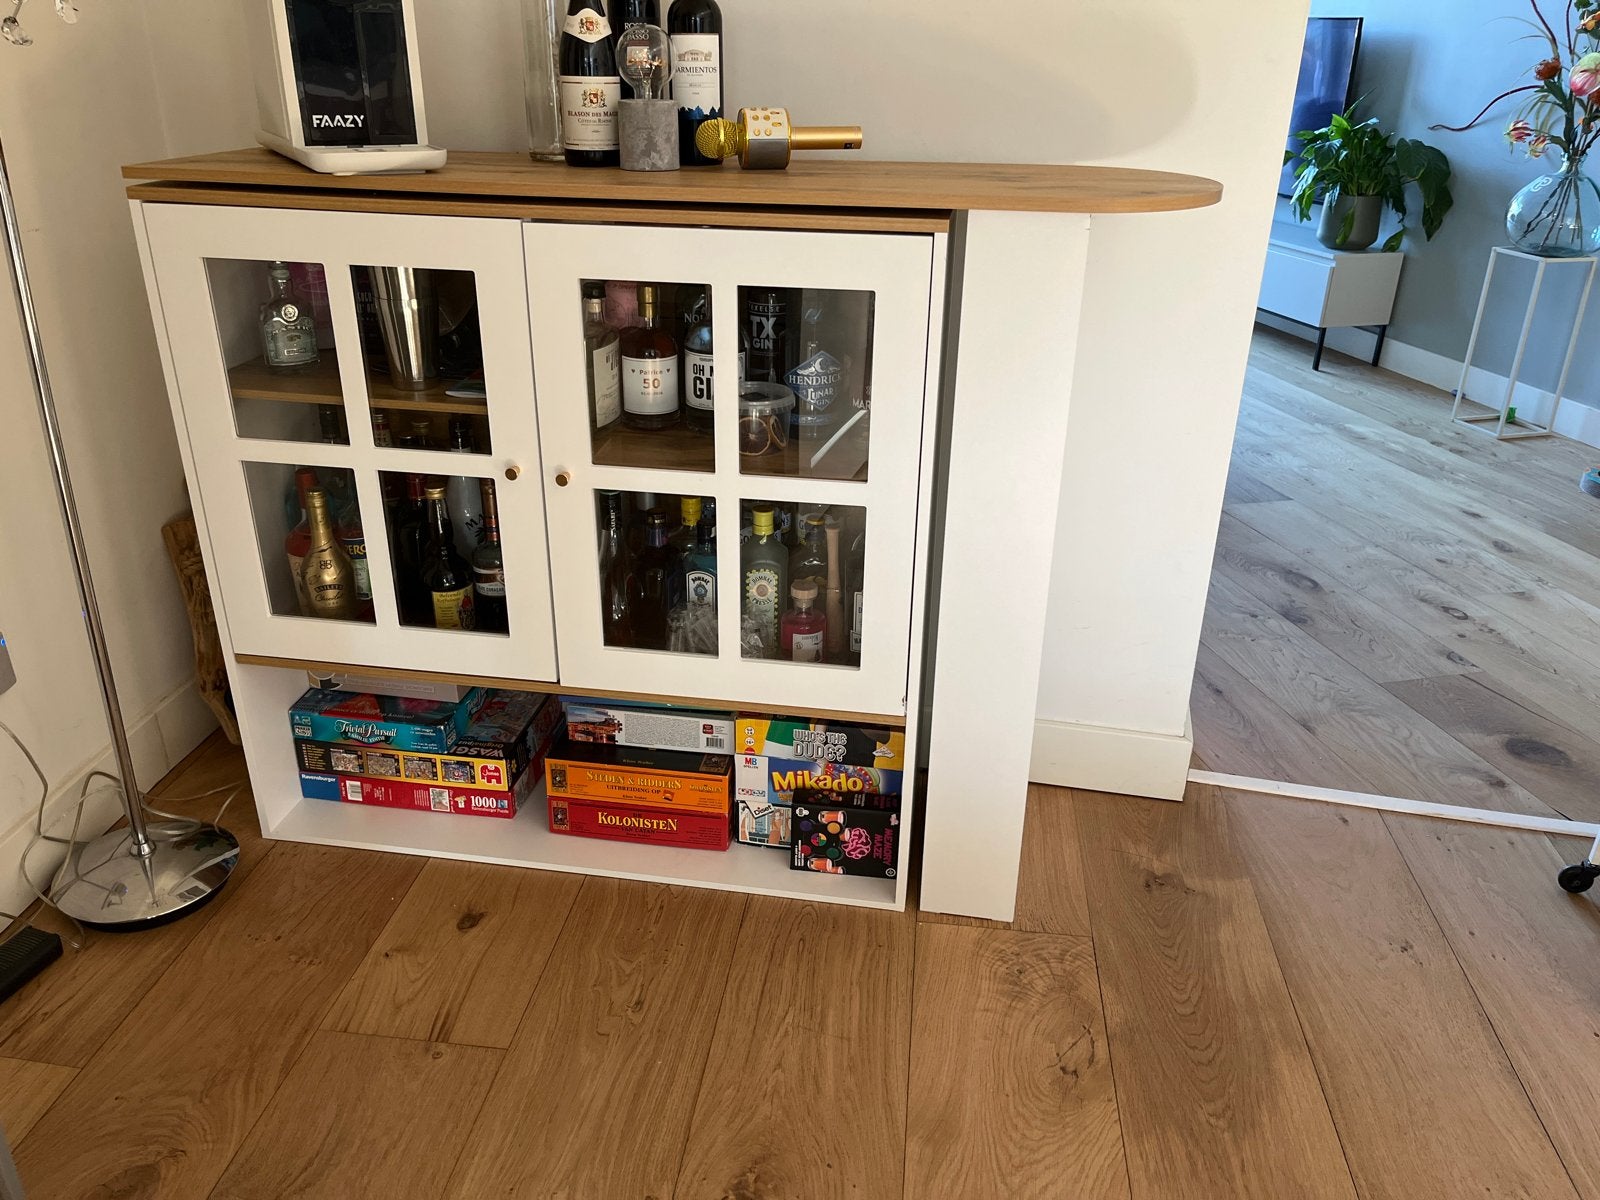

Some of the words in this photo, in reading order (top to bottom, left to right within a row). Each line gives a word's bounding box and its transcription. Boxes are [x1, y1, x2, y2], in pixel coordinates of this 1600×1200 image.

[312, 114, 365, 128] FAAZY
[750, 314, 777, 339] TX
[752, 338, 773, 350] GIN
[692, 363, 705, 376] OH
[643, 378, 661, 390] 50
[334, 719, 366, 734] Trivial
[366, 721, 398, 738] Pursuit
[793, 741, 847, 763] DUDE?
[744, 757, 758, 766] MB
[301, 773, 337, 783] Ravensburger
[627, 777, 635, 786] &
[770, 769, 864, 793] Mikado
[470, 795, 497, 809] 1000
[753, 804, 772, 816] Diset
[598, 811, 678, 832] KOLONISTEN
